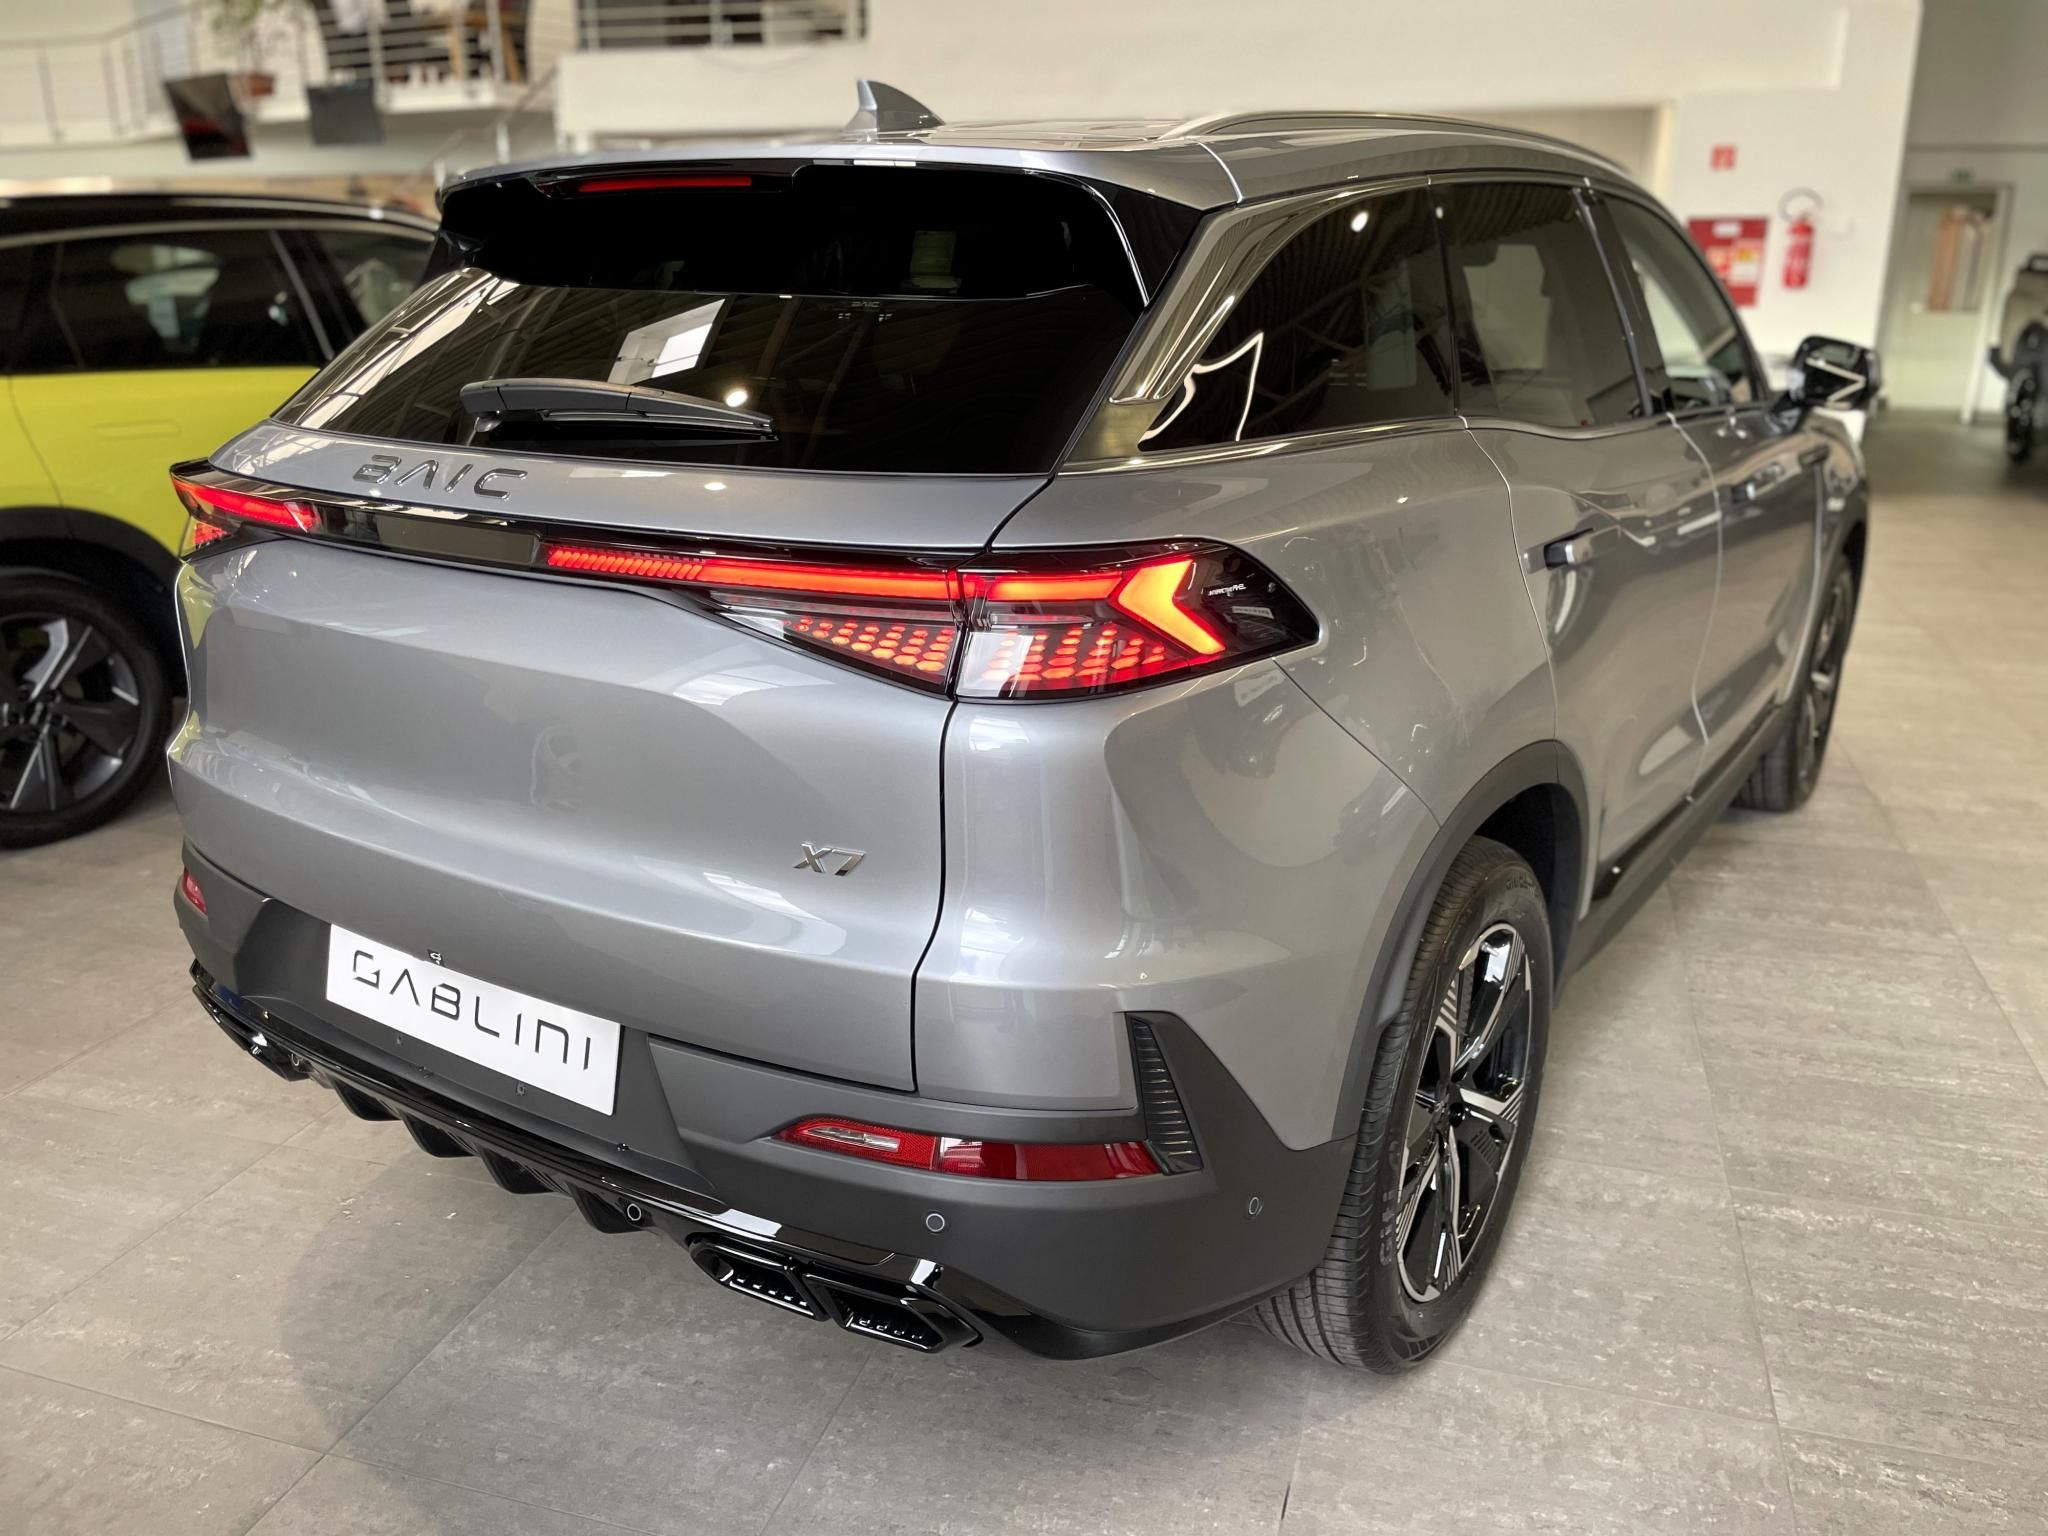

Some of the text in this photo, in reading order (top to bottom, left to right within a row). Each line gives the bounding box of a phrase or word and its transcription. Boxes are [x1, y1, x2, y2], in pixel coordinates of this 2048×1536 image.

[352, 454, 528, 499] BAIC
[793, 843, 866, 876] X7
[352, 949, 591, 1070] GABLINI
